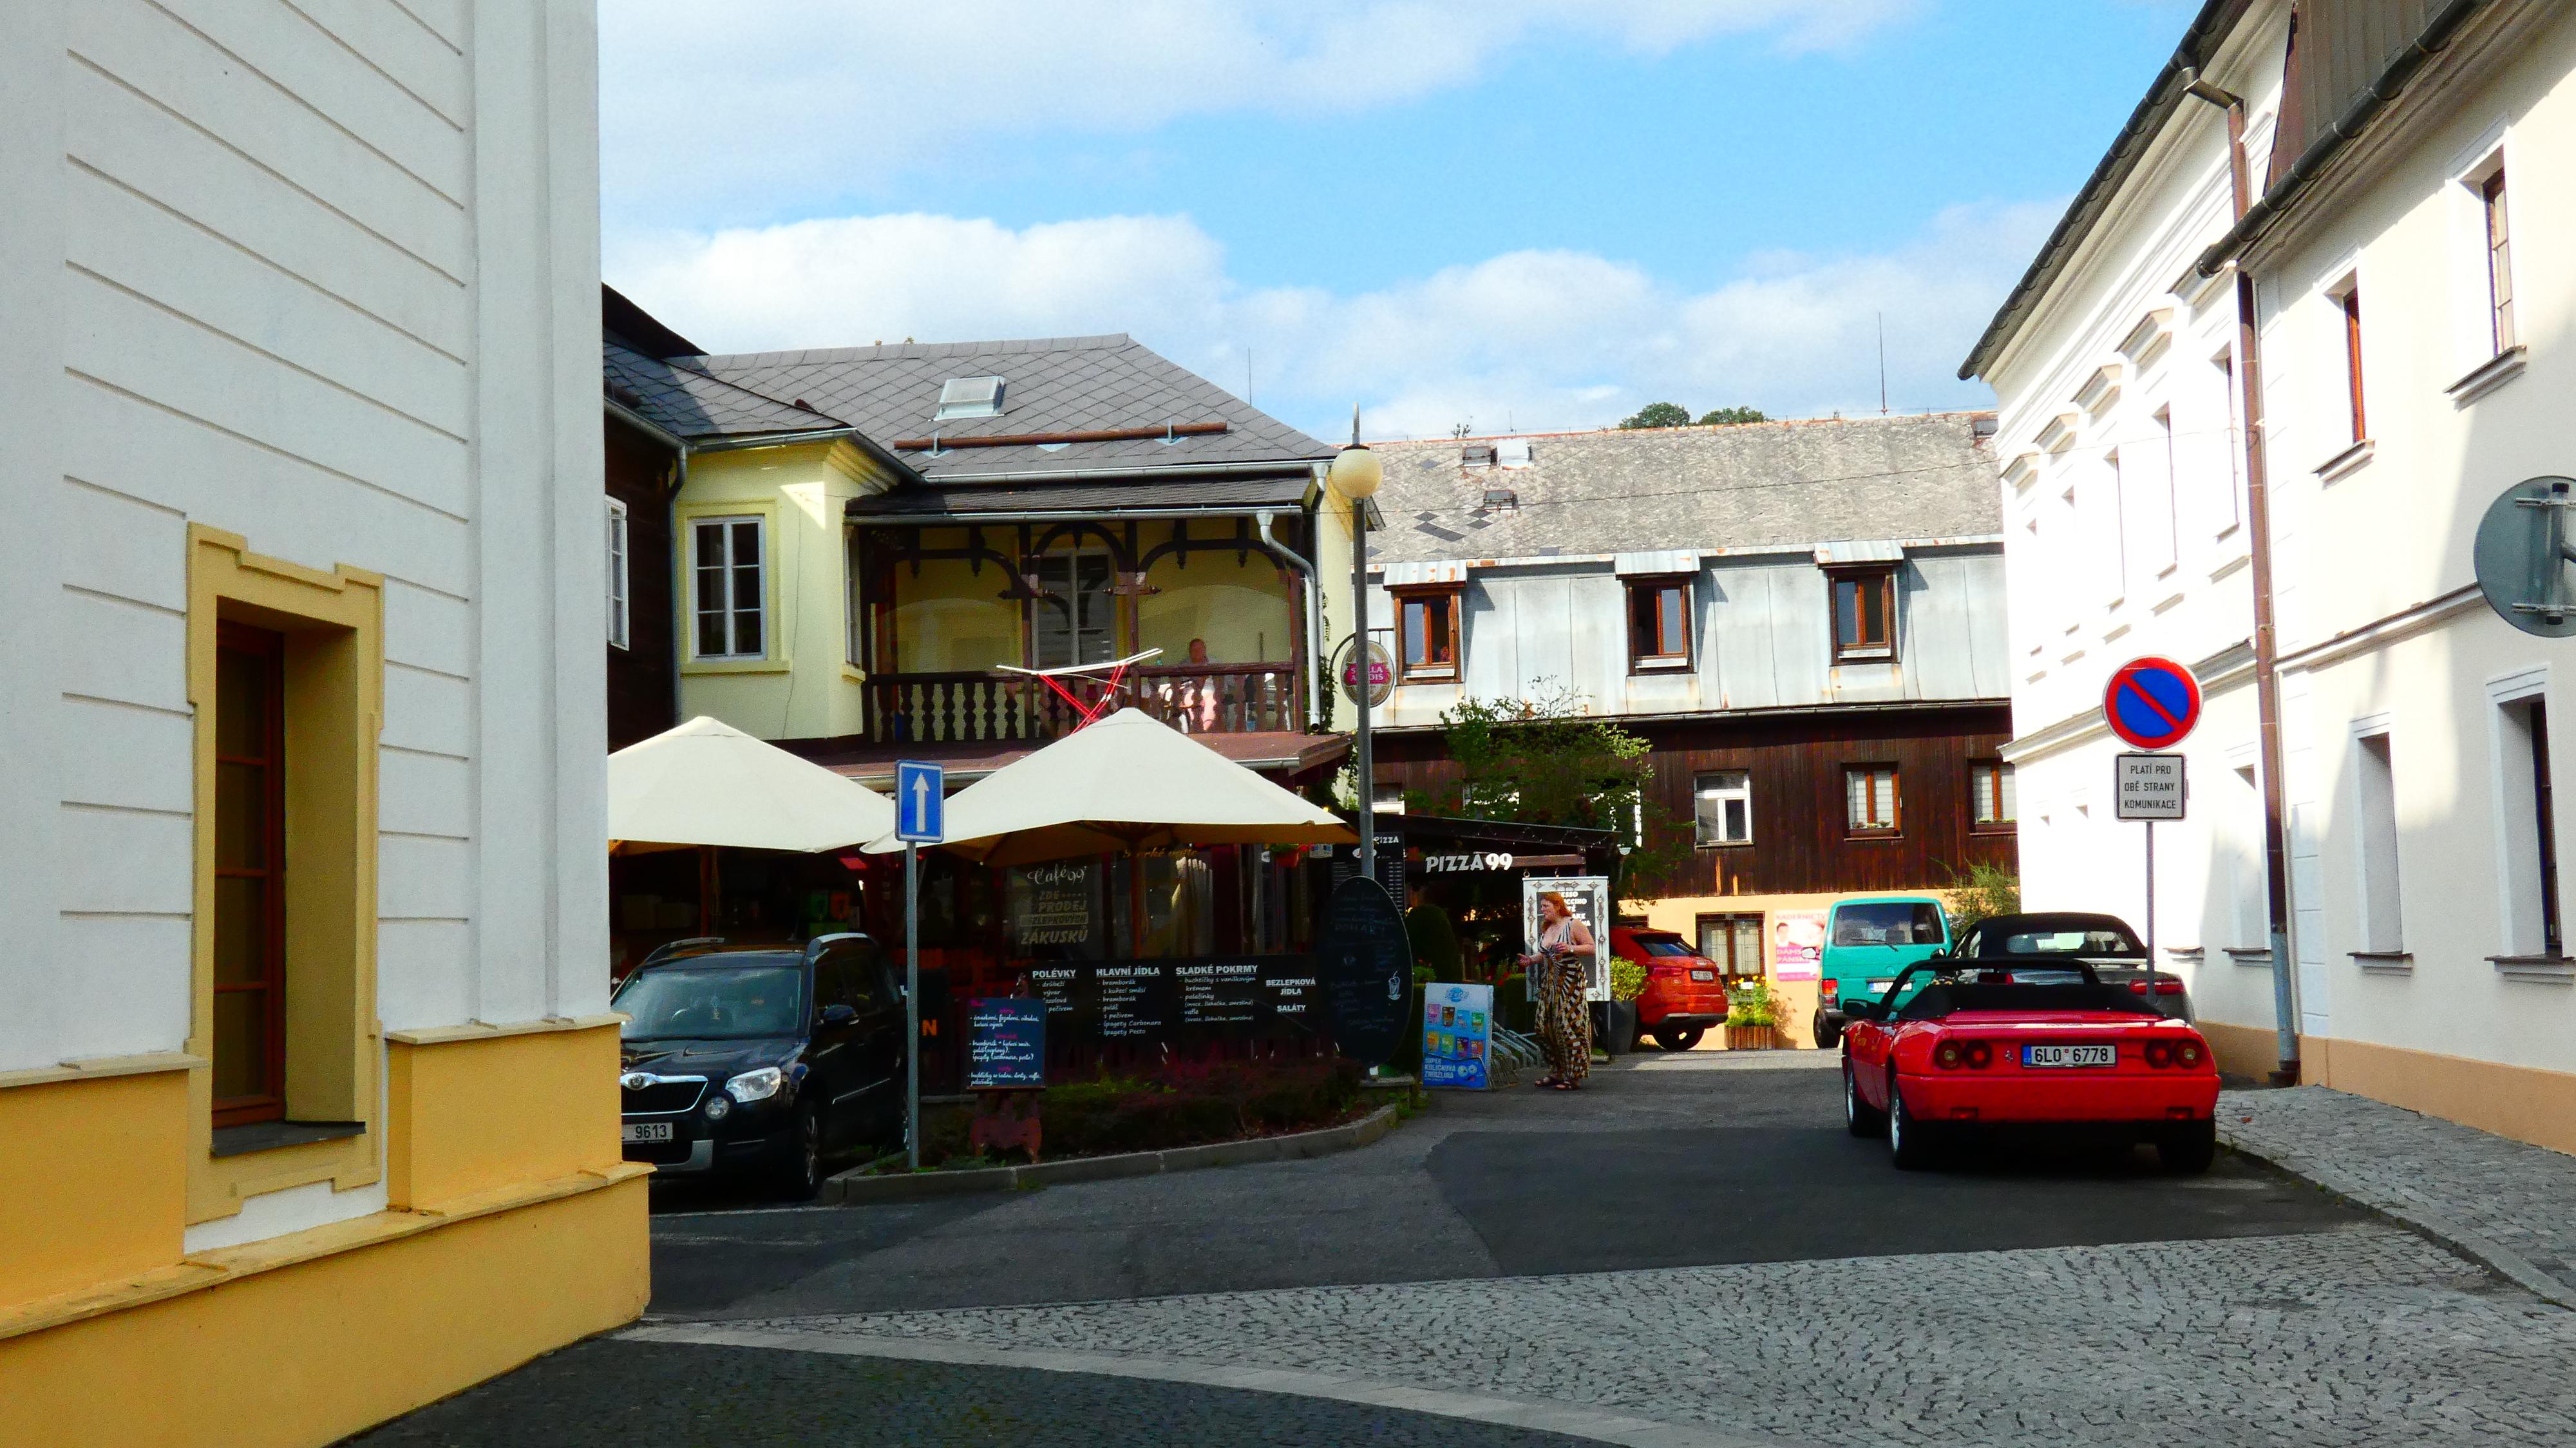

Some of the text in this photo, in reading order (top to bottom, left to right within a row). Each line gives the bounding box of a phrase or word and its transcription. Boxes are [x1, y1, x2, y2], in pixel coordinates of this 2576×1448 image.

[2130, 763, 2171, 774] PLATÍ PRO
[2124, 781, 2175, 792] OBĚ STRANY
[2124, 800, 2176, 809] KOMUNIKACE
[1425, 853, 1513, 873] PIZZA 99
[1021, 925, 1088, 944] ZÁKUSKŮ
[1032, 968, 1076, 978] POLÉVKY
[1096, 966, 1160, 976] HLAVNÍ JÍDLA
[1175, 964, 1258, 975] SLADKÉ POKRMY
[1265, 977, 1316, 986] BEZLEPKOVÁ
[1280, 987, 1302, 995] JÍDLA
[1277, 1003, 1306, 1012] SALÁTY
[1103, 1020, 1127, 1029] špagety
[1103, 1028, 1127, 1036] špagety
[2034, 1047, 2108, 1062] 6L0 6778
[636, 1125, 667, 1139] 9613
